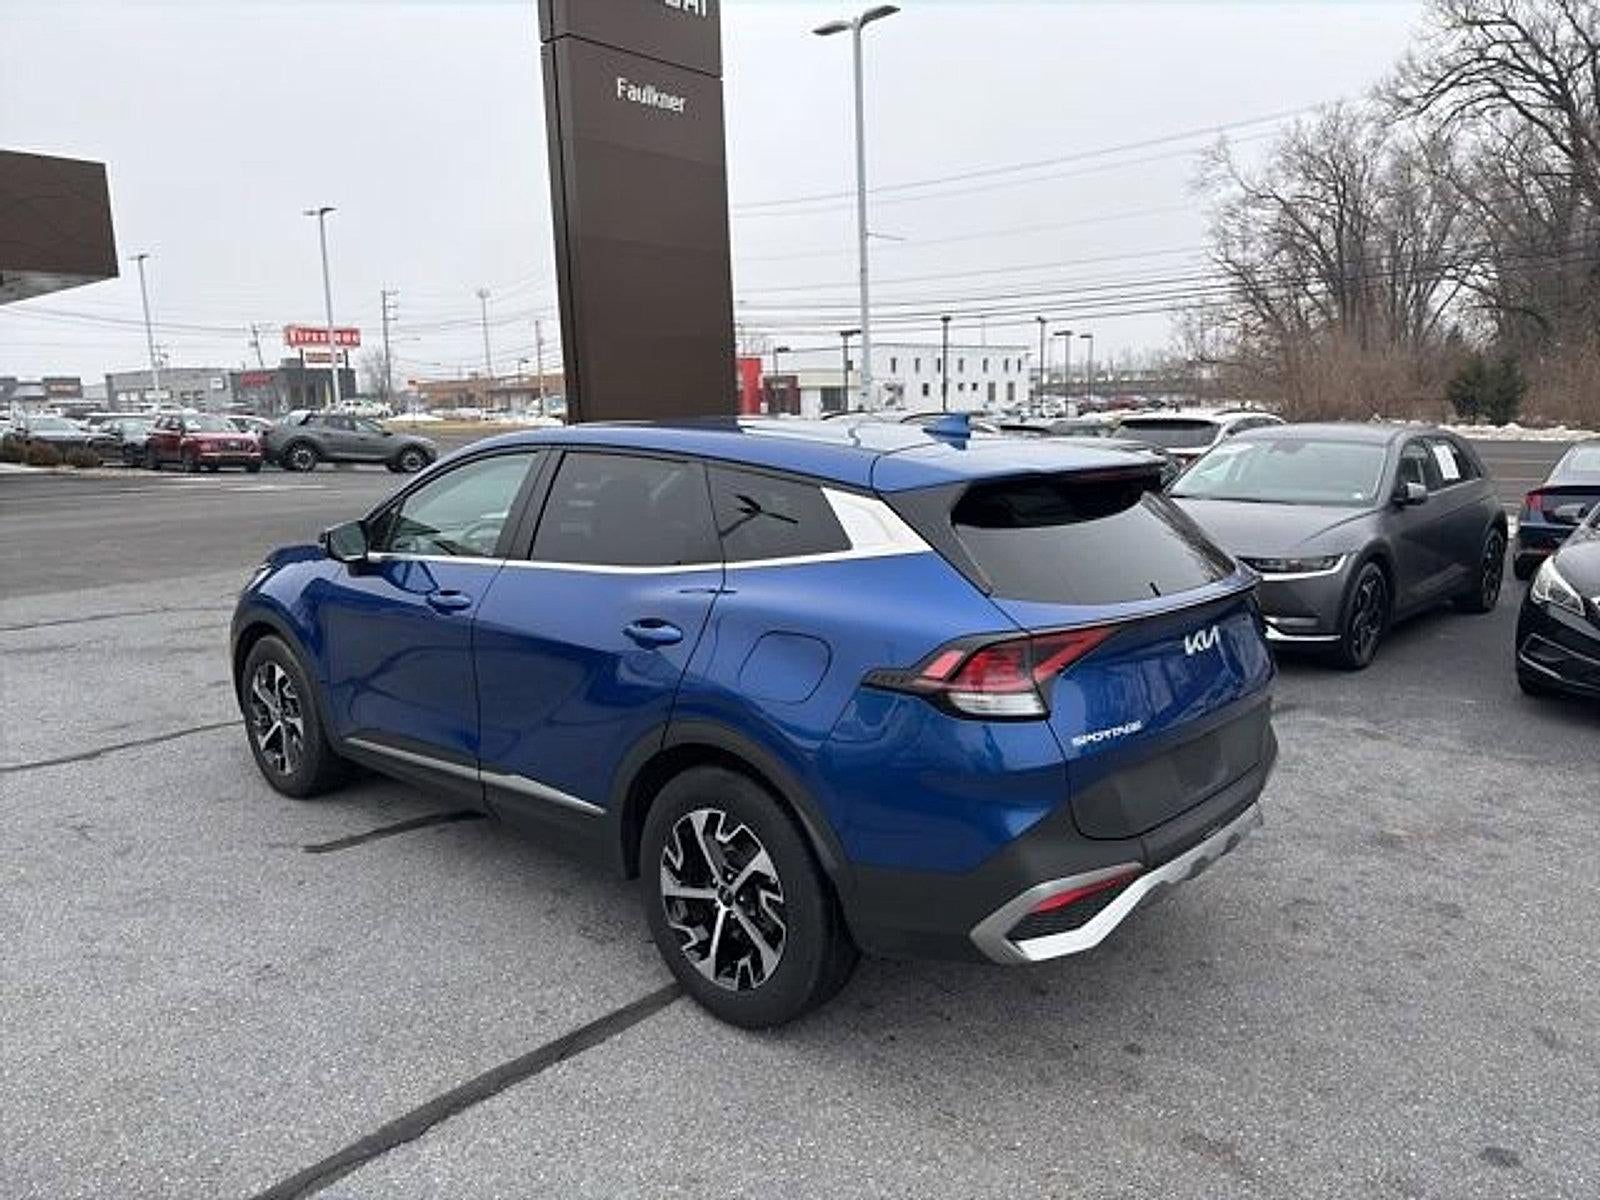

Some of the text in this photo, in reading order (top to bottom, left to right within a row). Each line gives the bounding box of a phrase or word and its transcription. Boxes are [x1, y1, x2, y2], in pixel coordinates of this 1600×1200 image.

[616, 77, 686, 113] Faulkner
[1184, 625, 1220, 656] KIA
[1072, 720, 1142, 746] SPORTAGE
